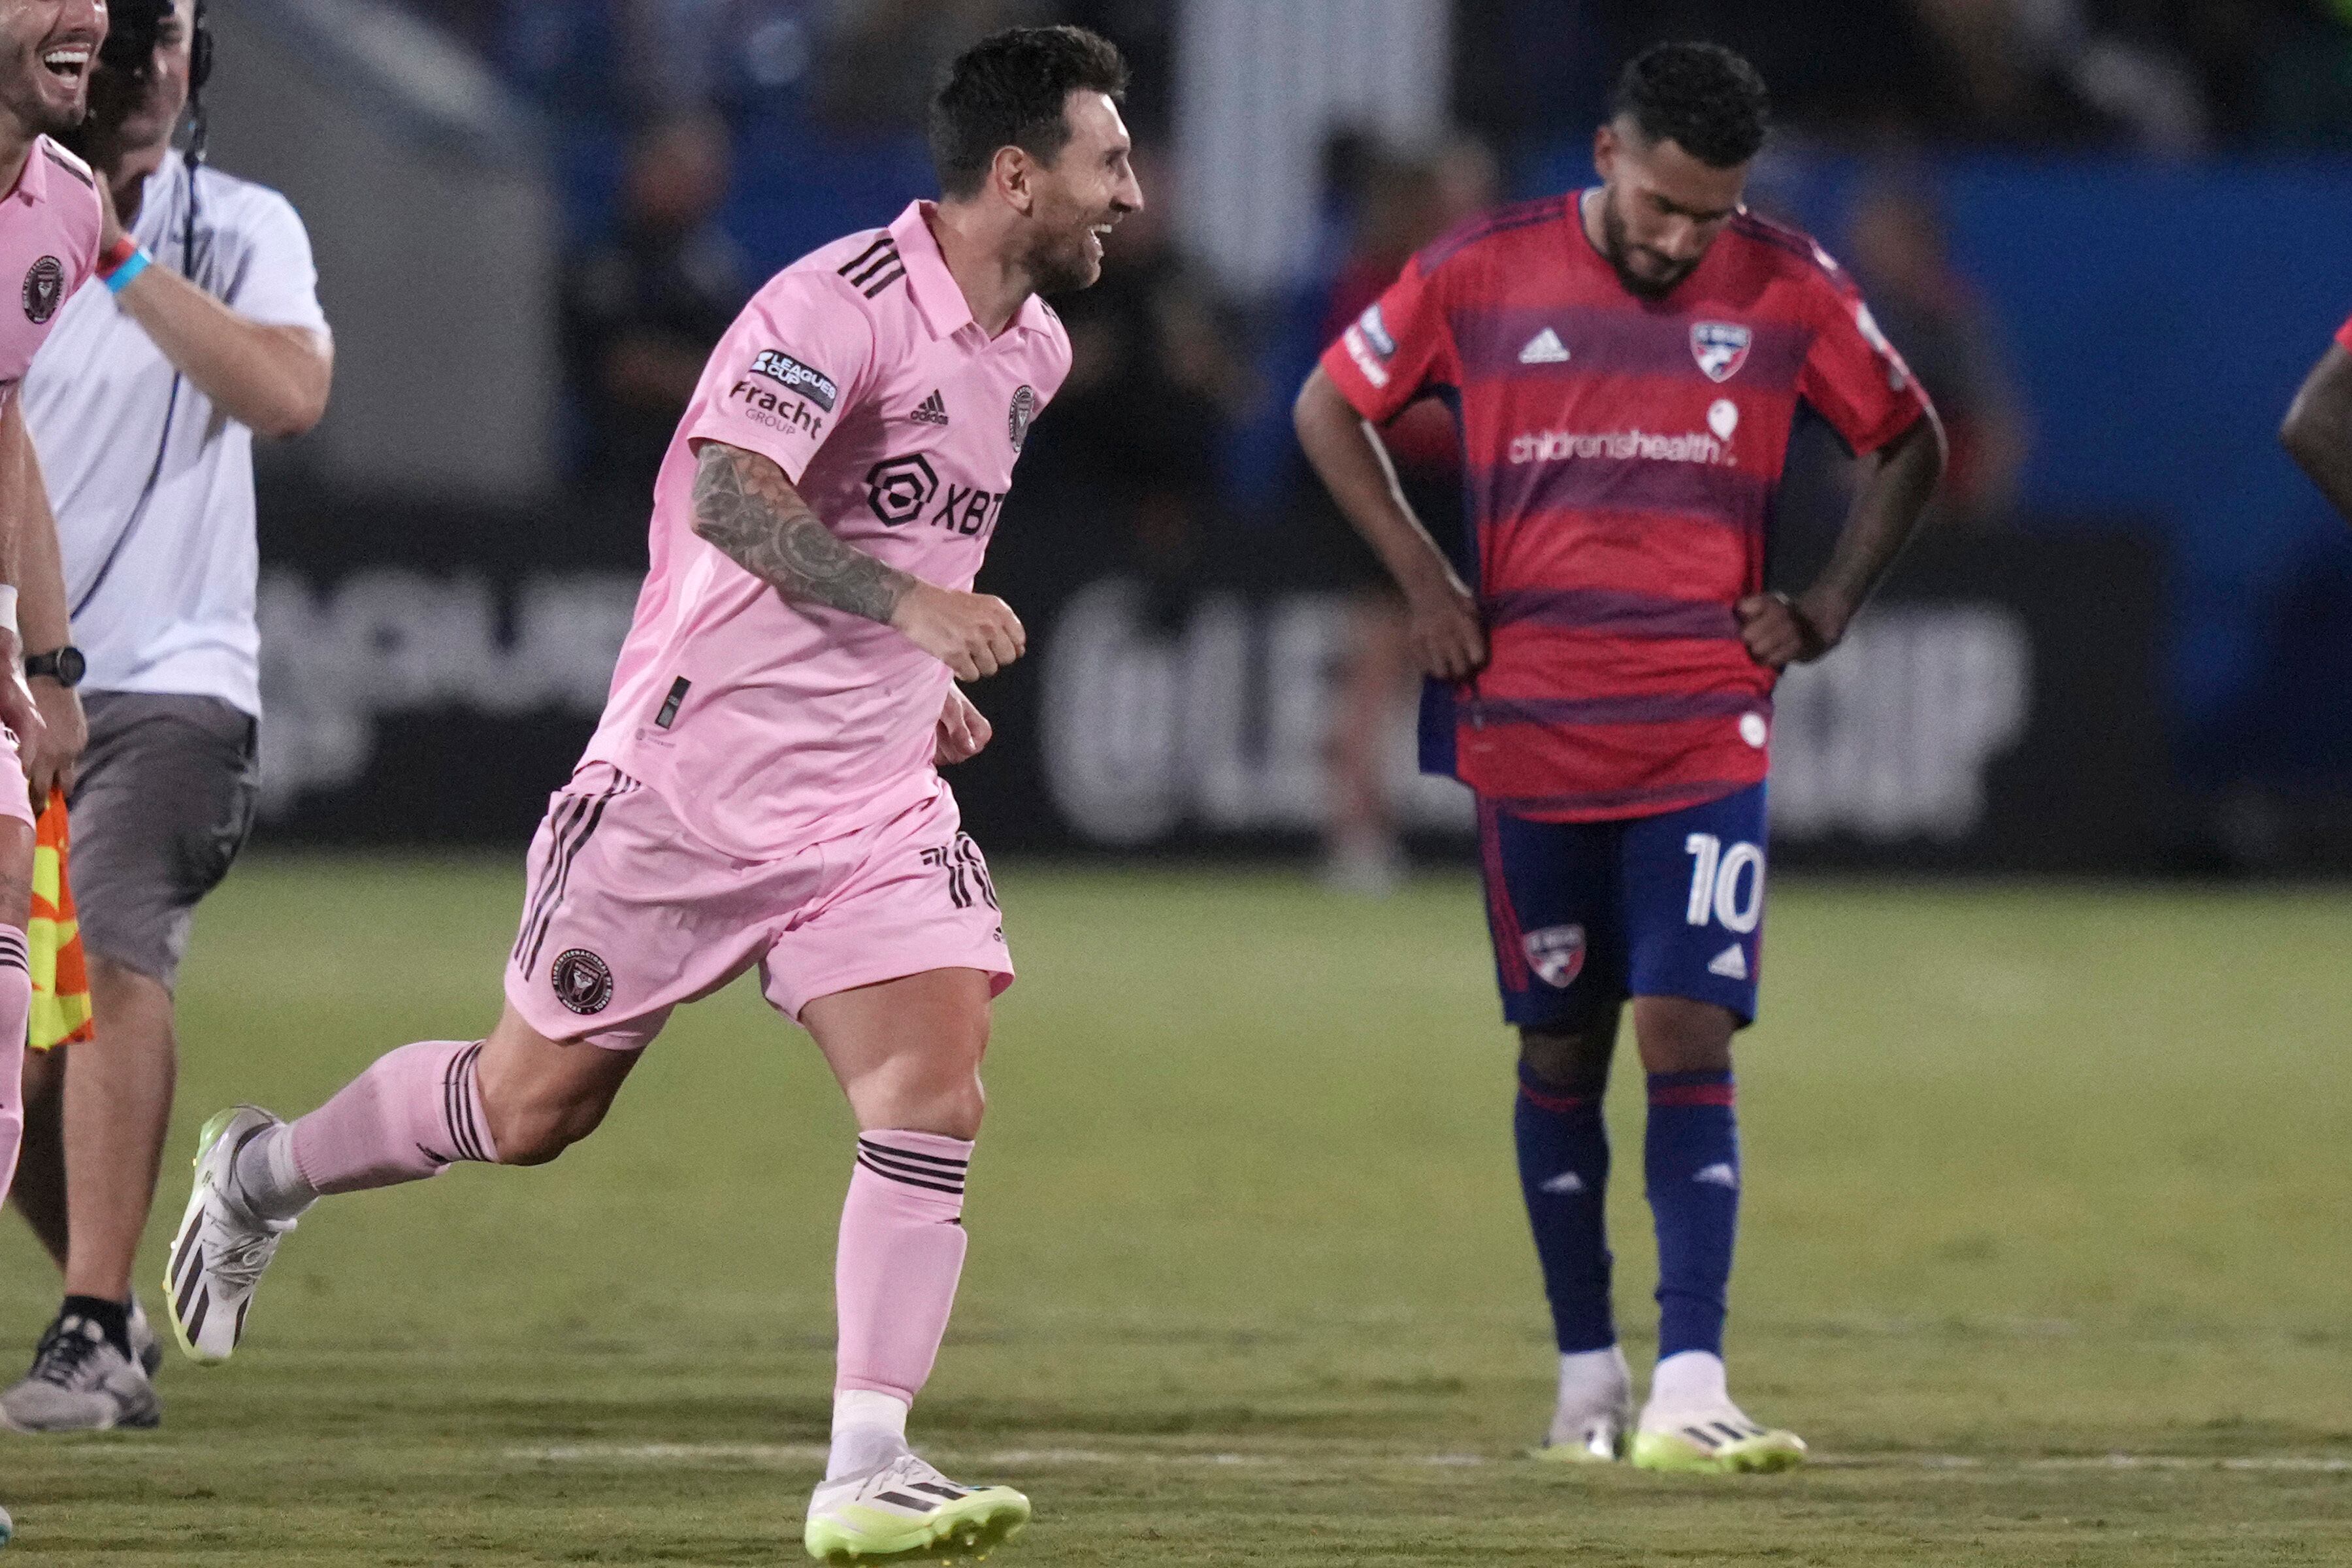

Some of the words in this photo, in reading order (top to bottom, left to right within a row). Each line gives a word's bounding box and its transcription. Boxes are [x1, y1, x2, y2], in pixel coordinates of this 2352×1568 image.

[767, 365, 801, 385] CUP
[771, 354, 837, 399] LEAGUES
[728, 380, 822, 440] Fracht
[745, 408, 796, 434] GROUP
[1685, 833, 1763, 934] 10
